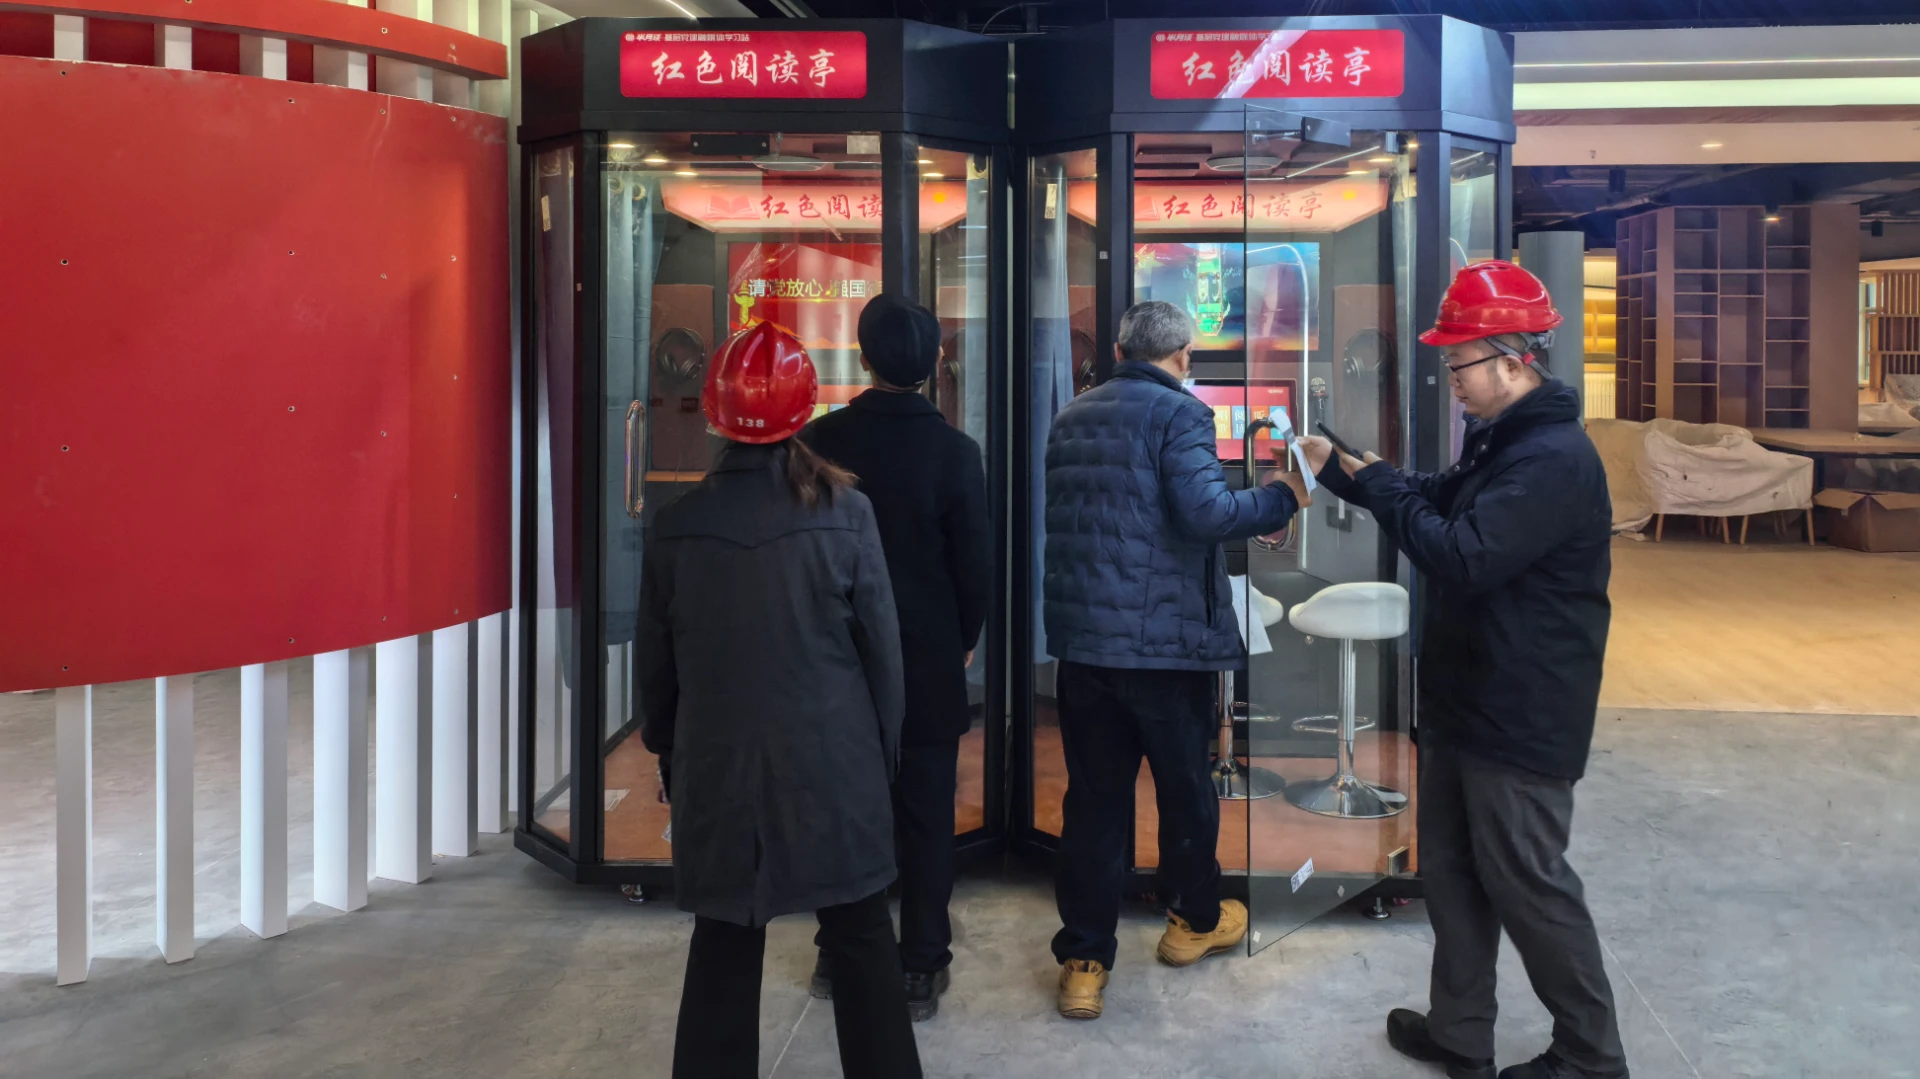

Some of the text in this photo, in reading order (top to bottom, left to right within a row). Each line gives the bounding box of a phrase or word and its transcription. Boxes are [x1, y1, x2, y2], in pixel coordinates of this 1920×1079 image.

[651, 48, 836, 88] 红色阅读亭
[1182, 46, 1371, 87] 红色阅读亭
[1163, 191, 1323, 220] 红色阅读亭
[736, 417, 765, 428] 138
